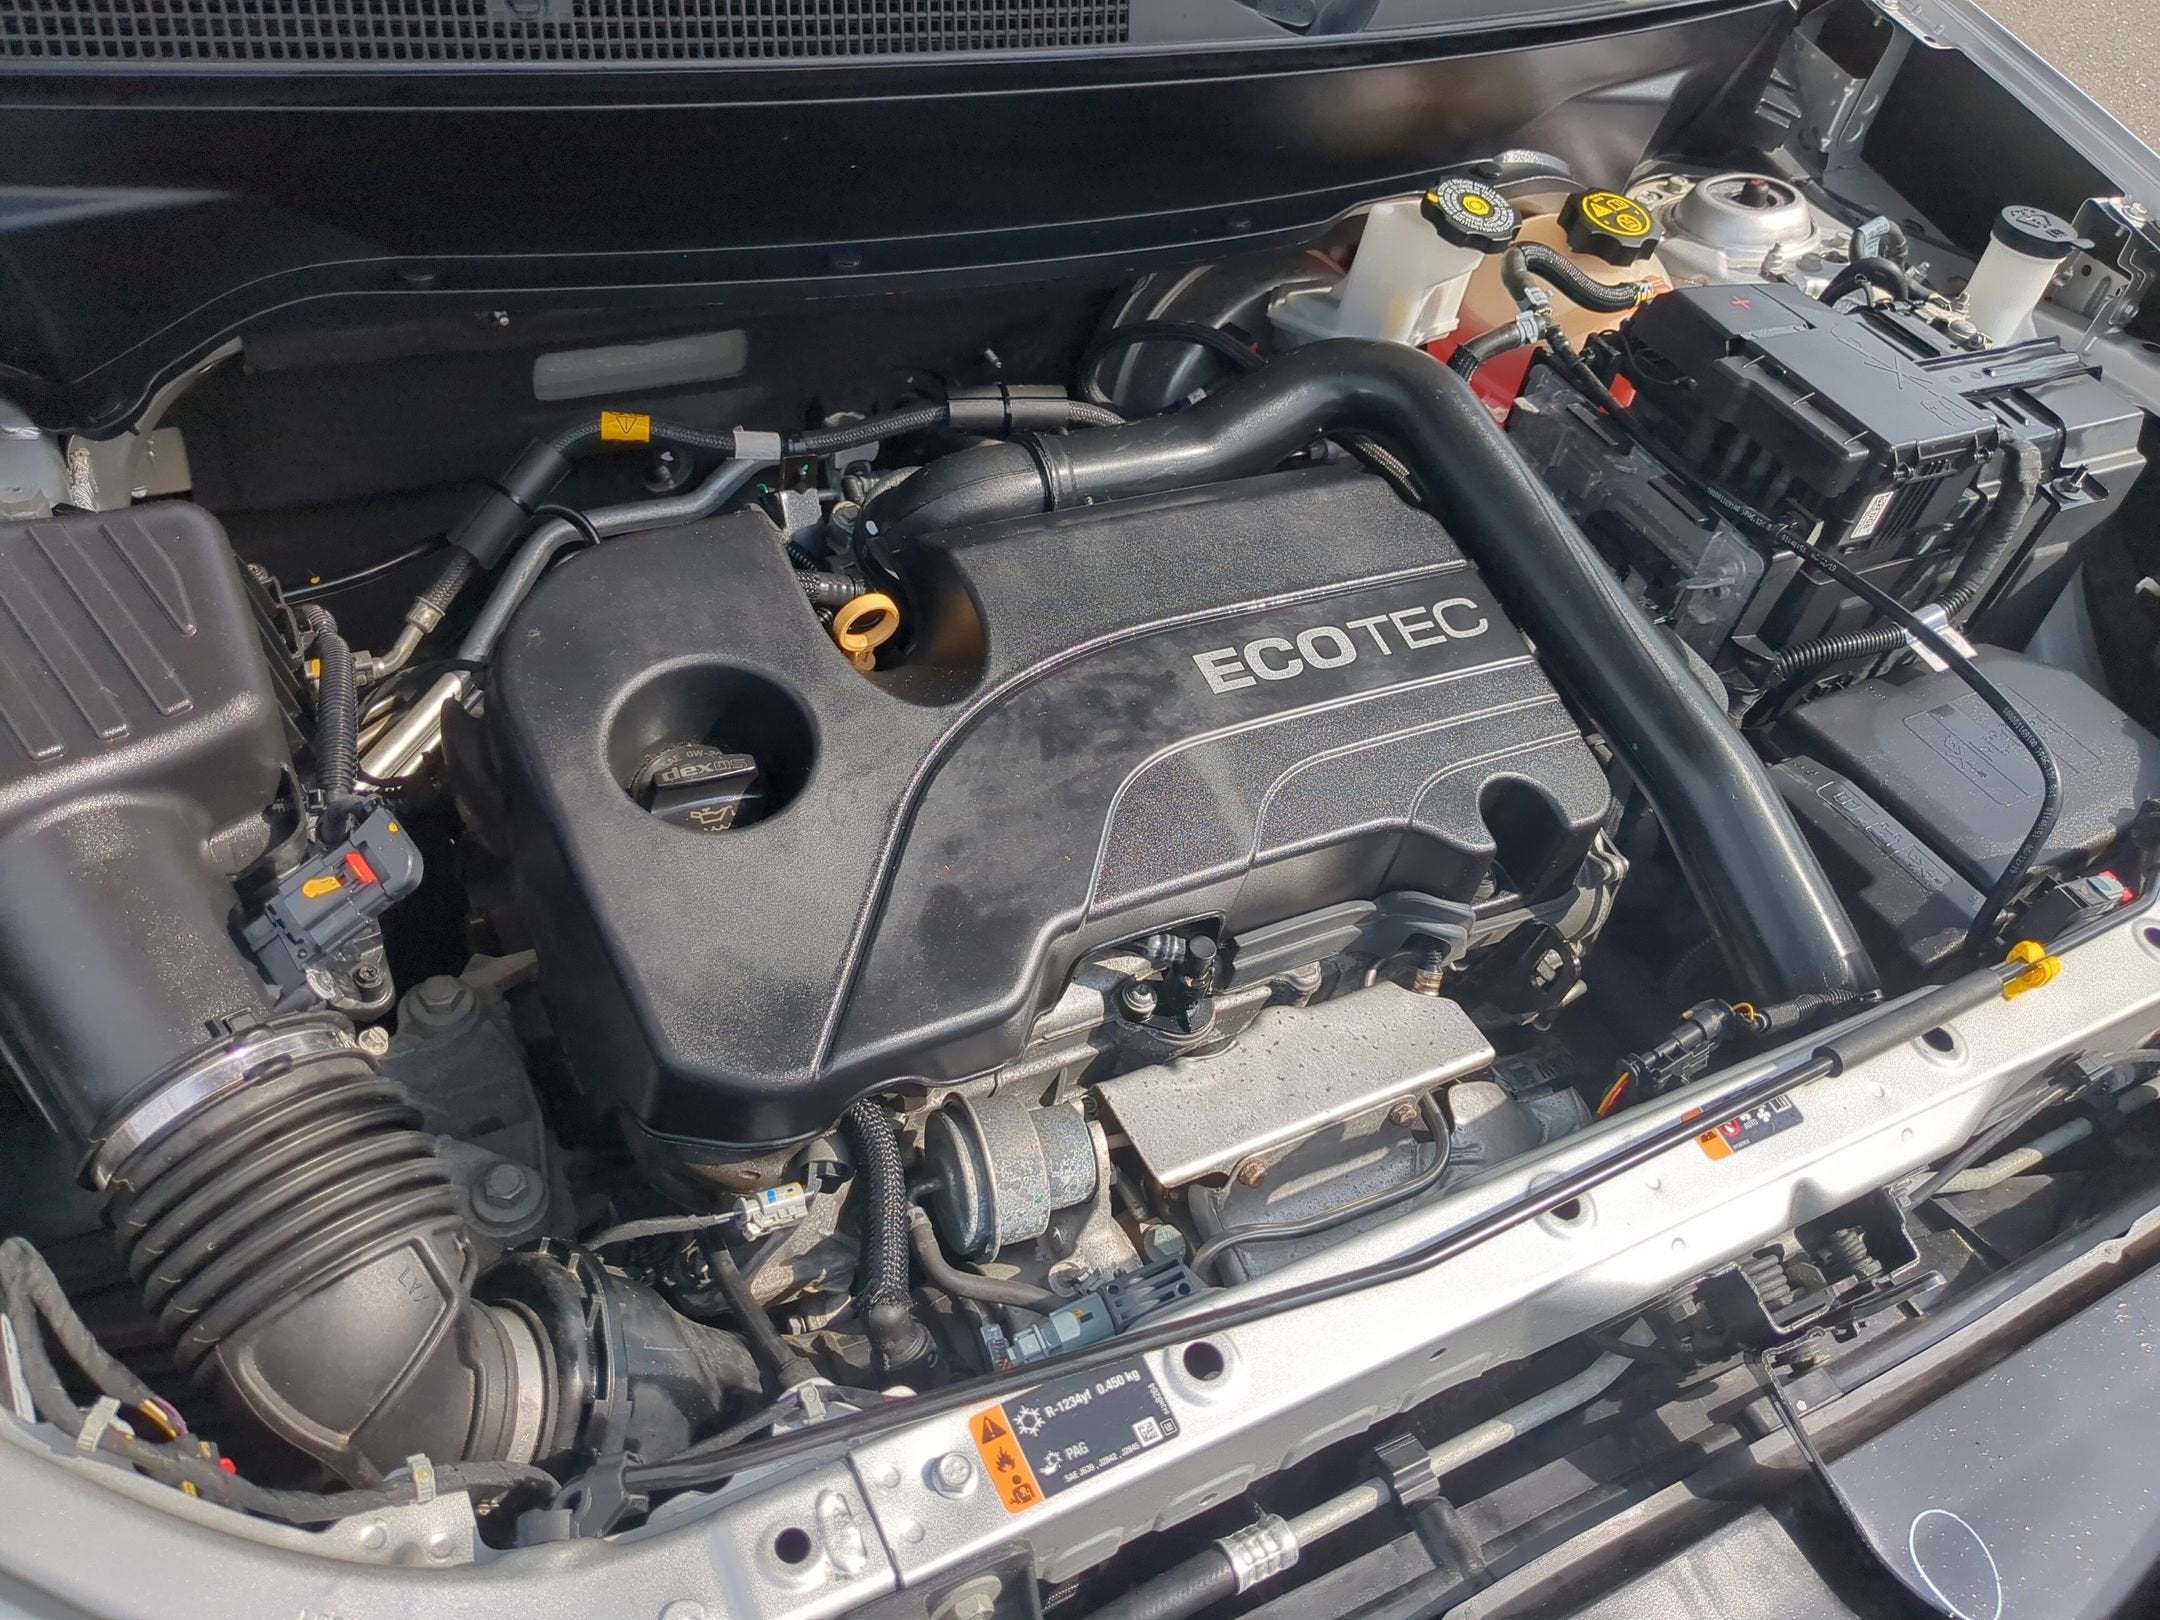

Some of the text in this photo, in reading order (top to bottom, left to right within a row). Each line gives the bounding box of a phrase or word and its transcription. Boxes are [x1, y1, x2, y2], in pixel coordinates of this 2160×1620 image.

[1191, 597, 1489, 695] ECOTEC
[661, 758, 748, 783] dexos
[1044, 1369, 1140, 1419] R-1234yf 0.450 kg
[1065, 1441, 1089, 1460] PAG
[1064, 1470, 1080, 1483] SAE
